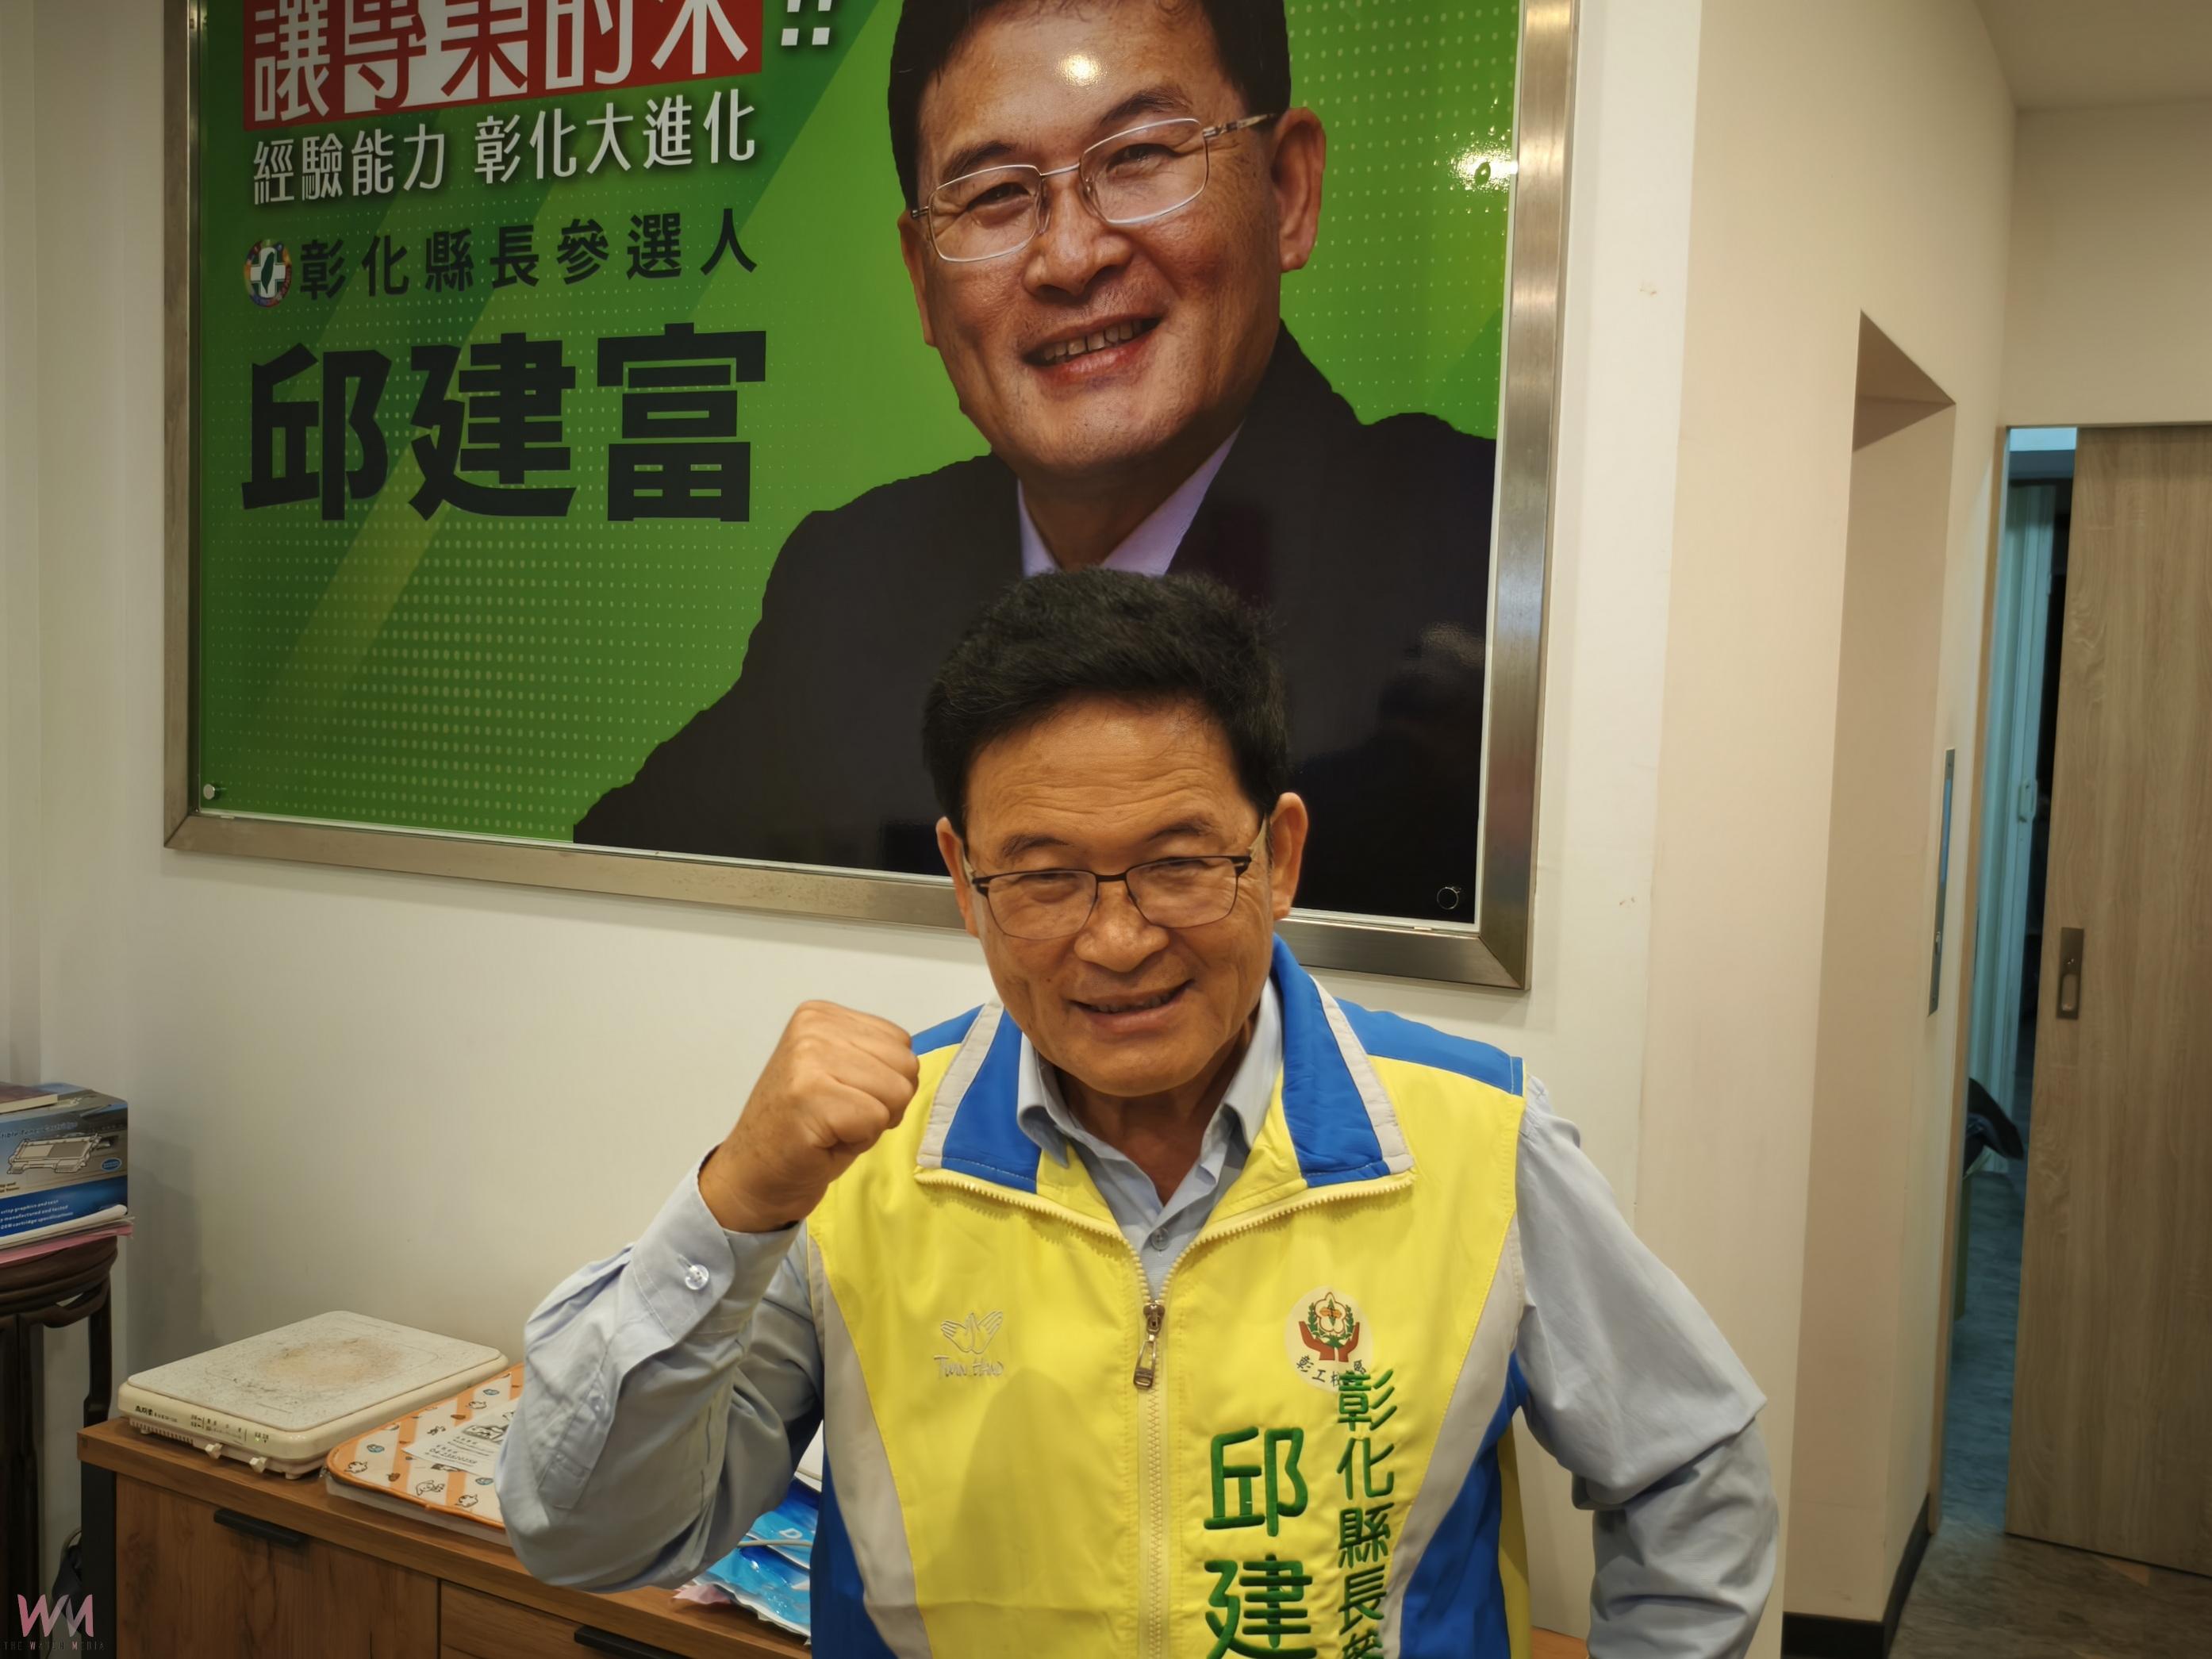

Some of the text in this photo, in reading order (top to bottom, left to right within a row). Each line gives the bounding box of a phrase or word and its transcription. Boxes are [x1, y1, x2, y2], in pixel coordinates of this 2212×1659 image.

[252, 89, 756, 205] 經驗能力 彰化大進化
[299, 208, 758, 301] 彰化縣長參選人
[241, 322, 767, 523] 邱建富
[1204, 1427, 1317, 1659] 邱建
